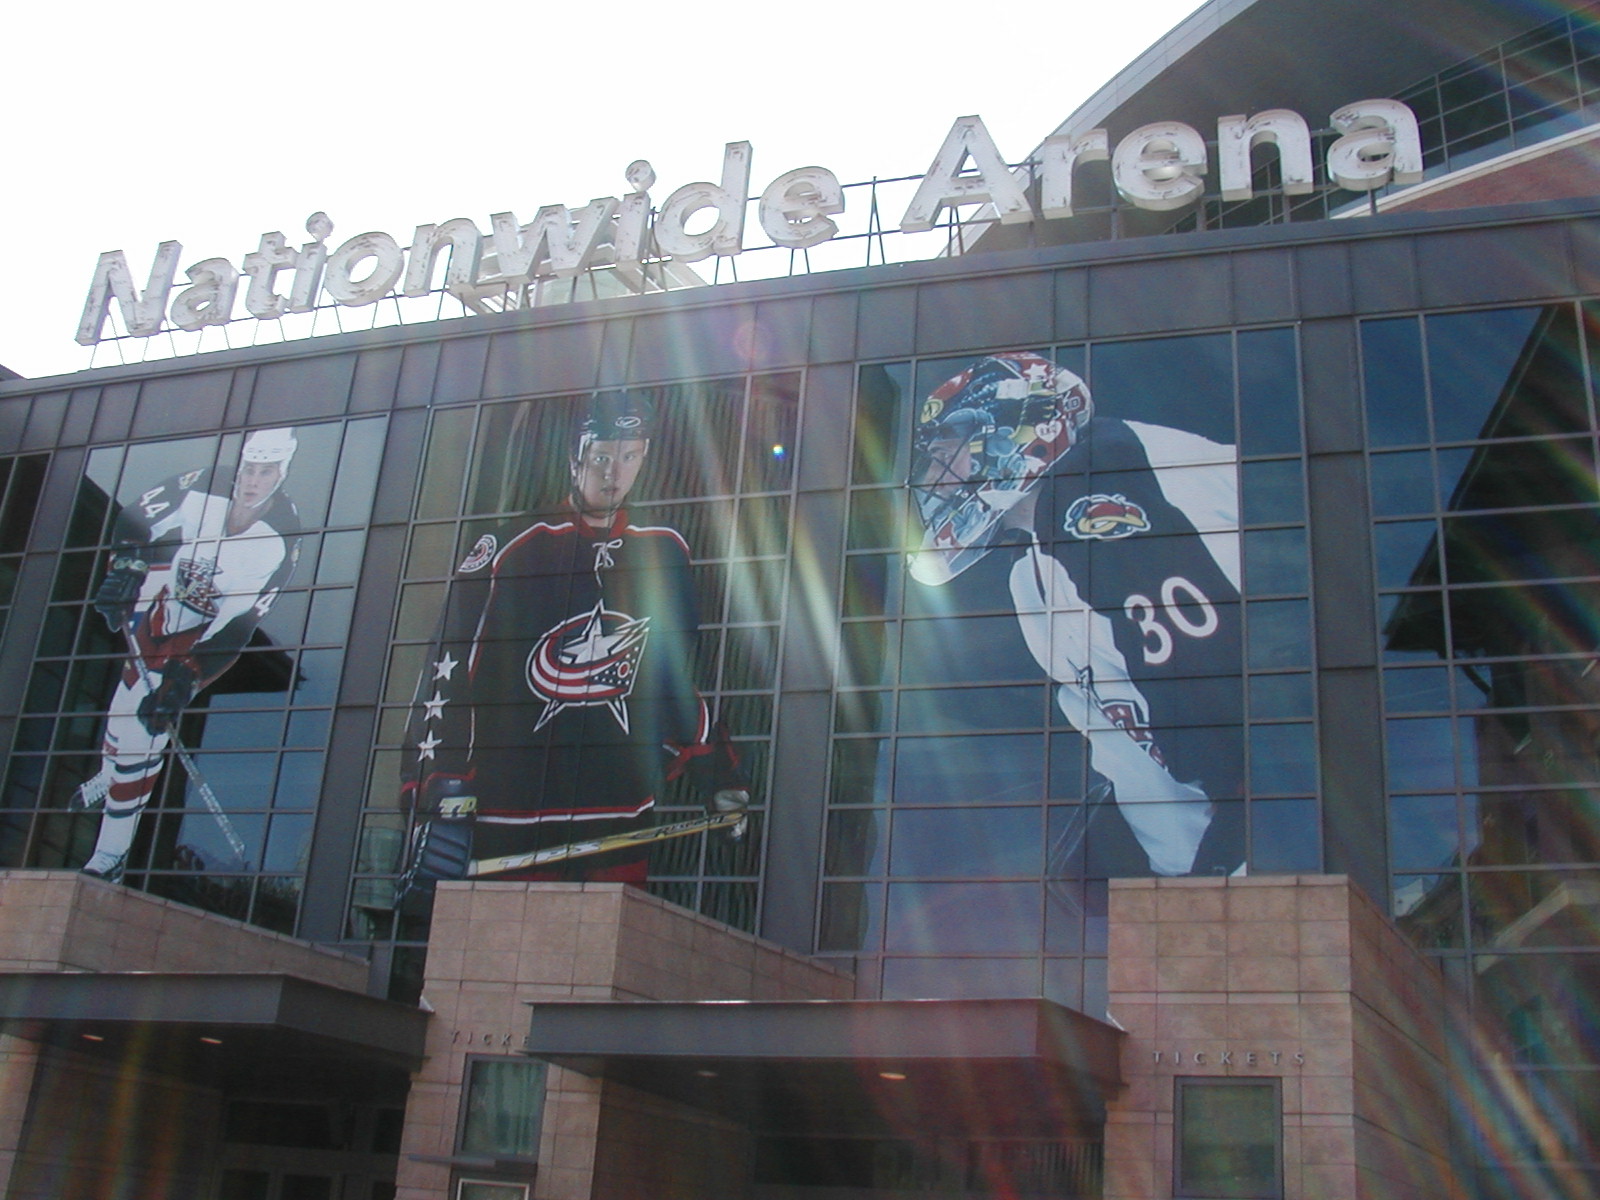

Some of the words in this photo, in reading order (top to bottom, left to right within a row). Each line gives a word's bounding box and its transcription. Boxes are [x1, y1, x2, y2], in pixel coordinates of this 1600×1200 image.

[75, 140, 845, 346] Nationwide
[900, 98, 1424, 234] Arena
[139, 486, 170, 519] 44
[1123, 576, 1219, 665] 30
[1152, 1051, 1305, 1066] TICKETS
